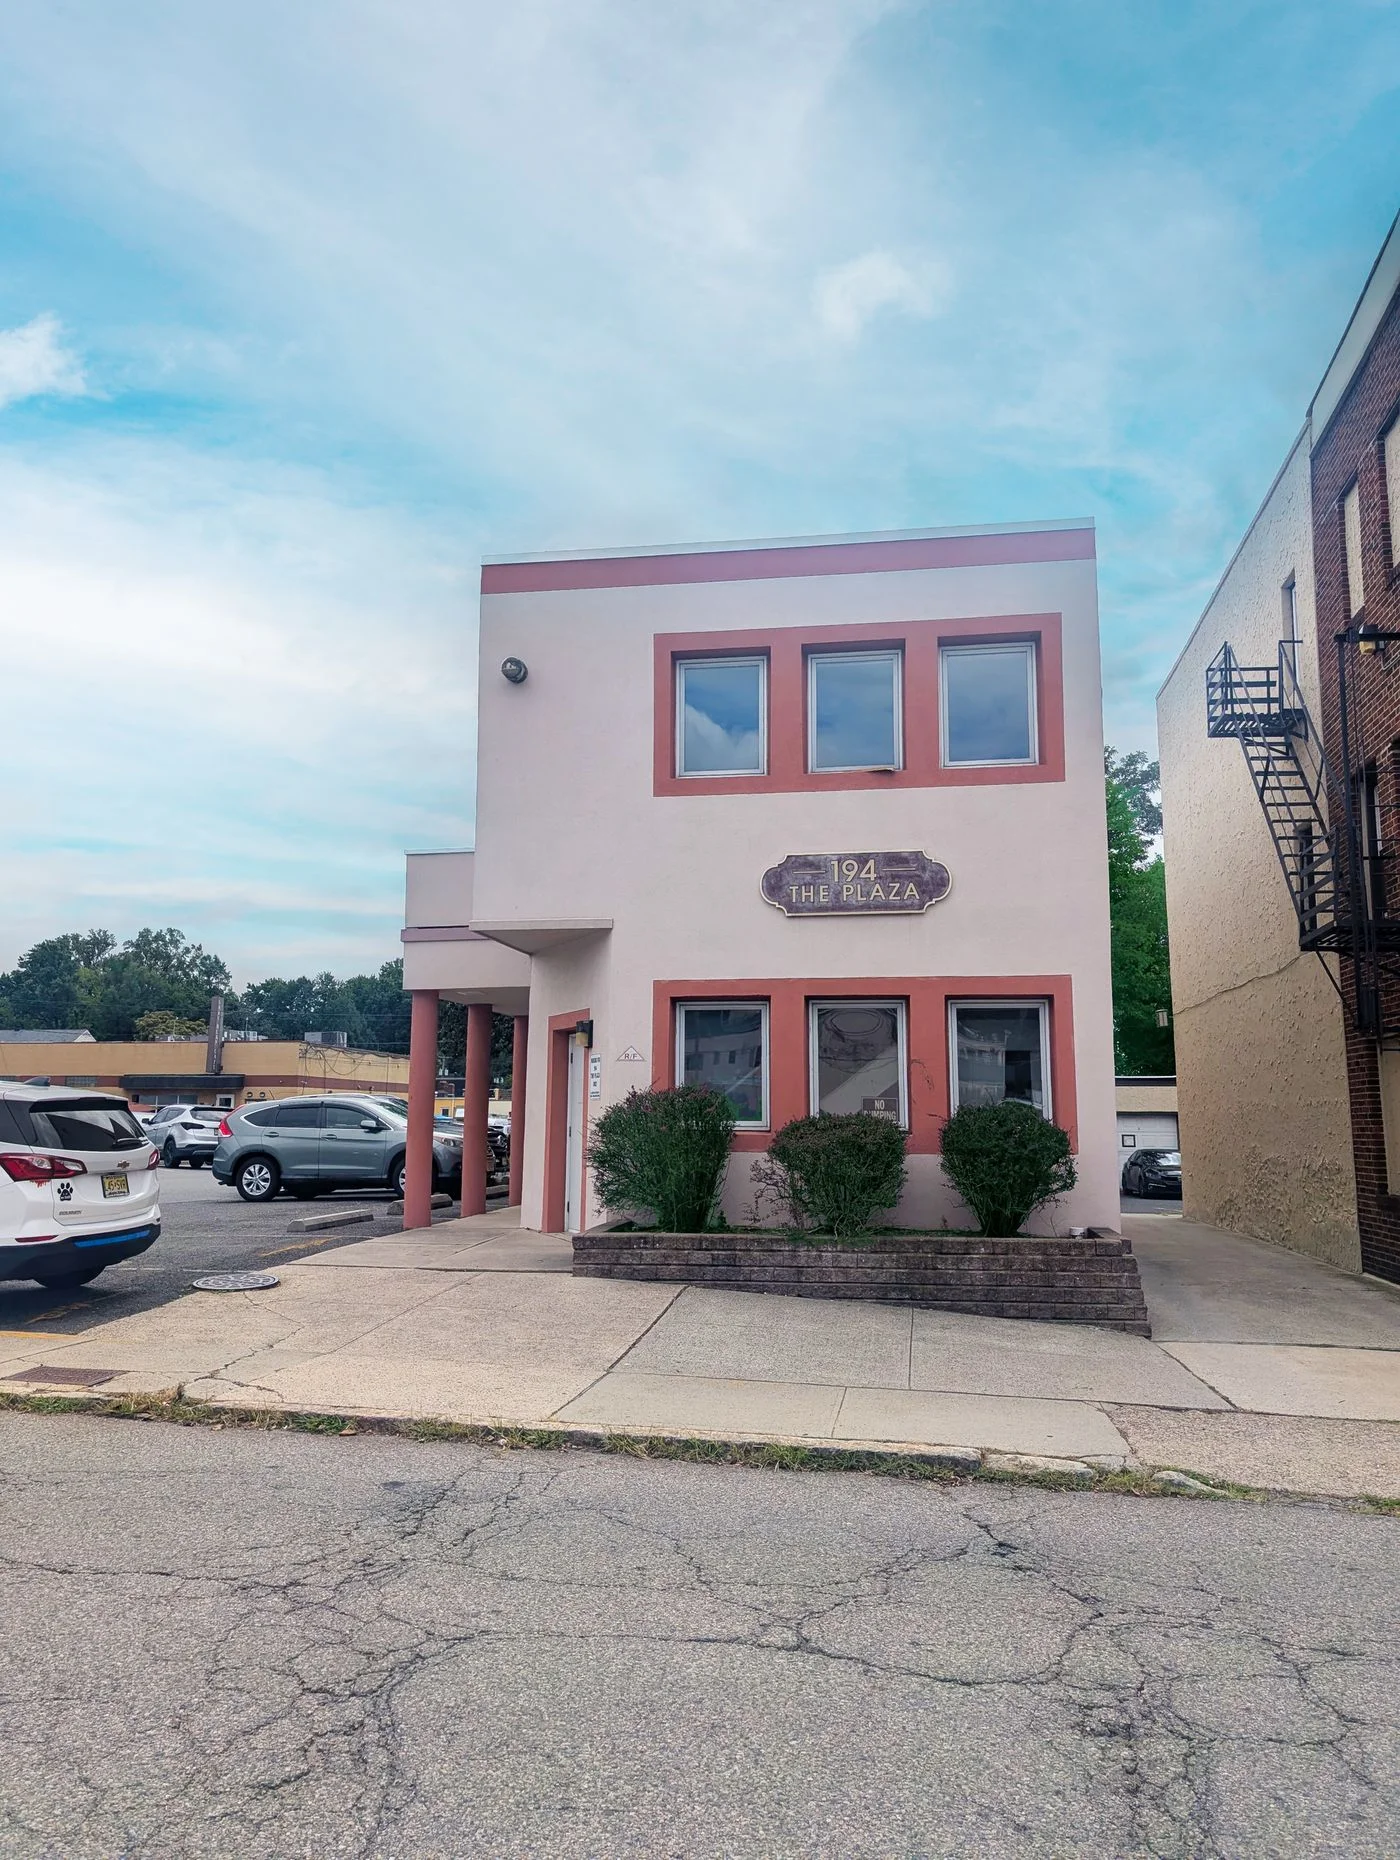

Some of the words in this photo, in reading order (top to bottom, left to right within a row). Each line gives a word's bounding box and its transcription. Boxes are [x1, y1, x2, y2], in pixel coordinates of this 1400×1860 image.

[830, 859, 877, 882] 194
[789, 884, 830, 903] THE
[842, 882, 920, 902] PLAZA
[874, 1099, 885, 1110] NO
